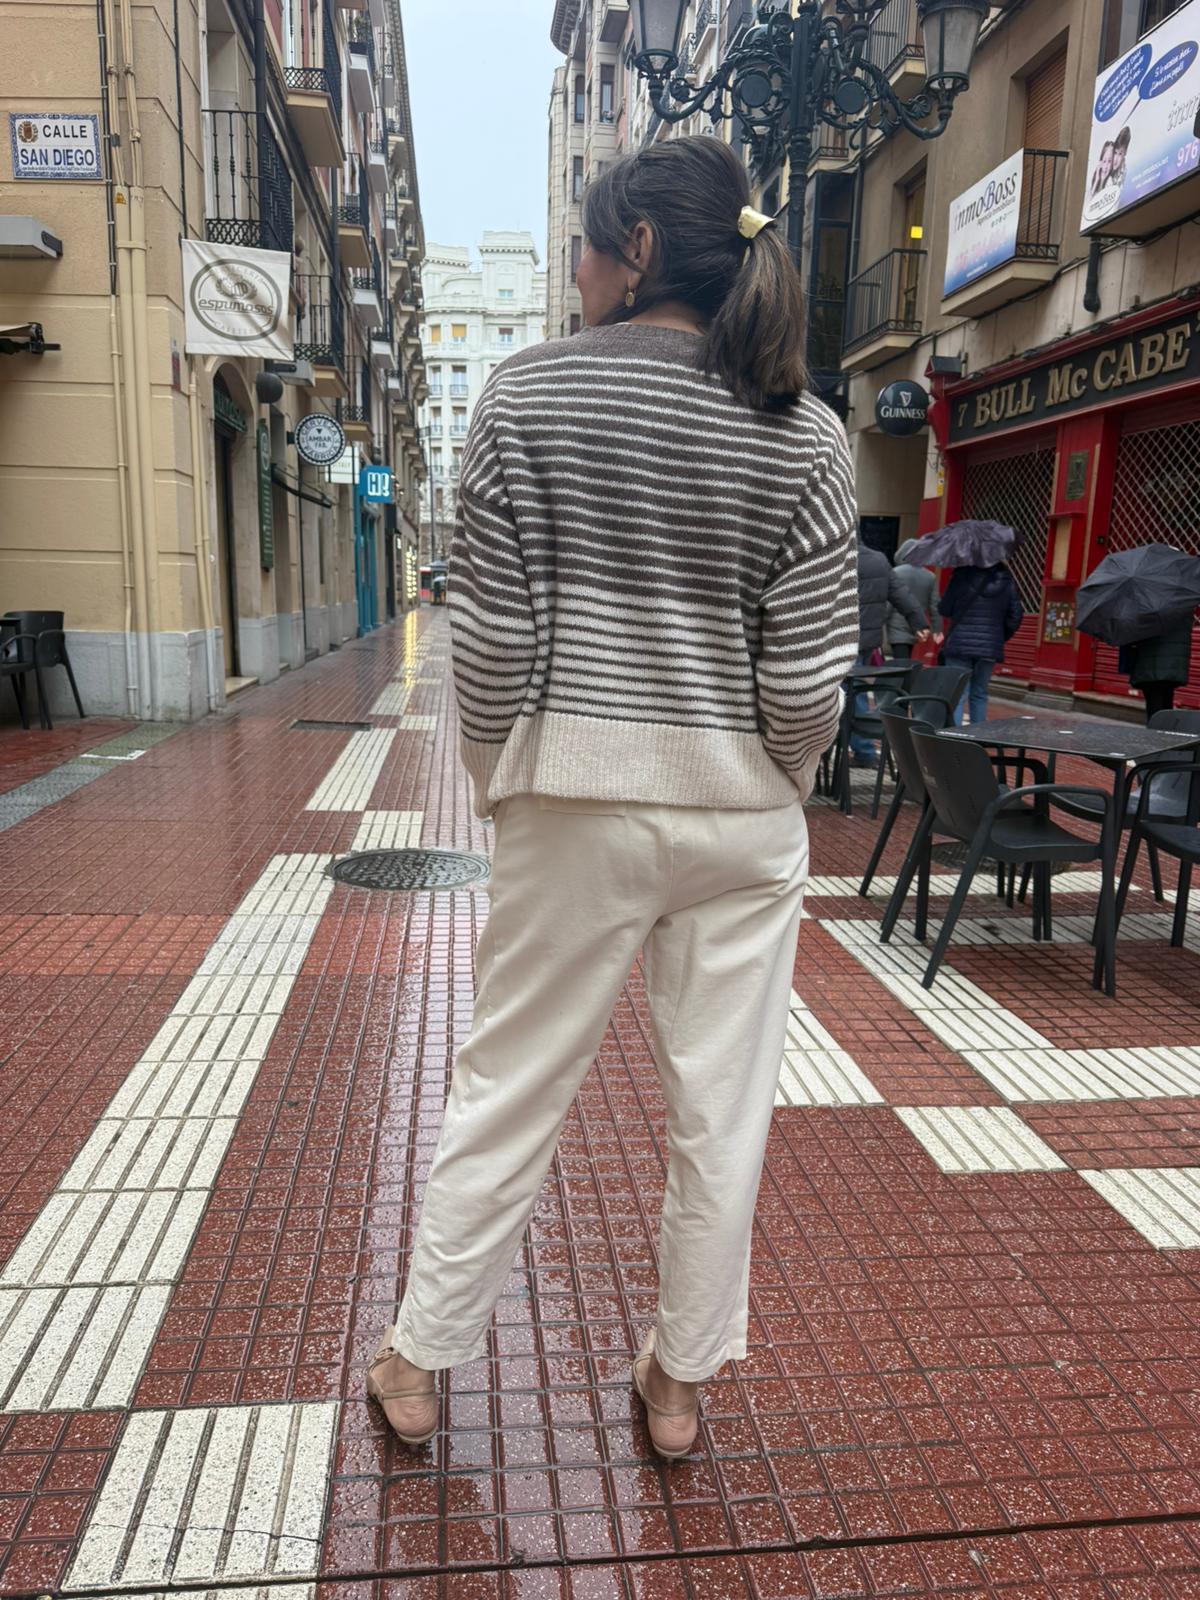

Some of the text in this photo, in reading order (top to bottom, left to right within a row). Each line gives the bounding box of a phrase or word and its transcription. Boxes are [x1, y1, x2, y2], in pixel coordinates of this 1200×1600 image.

[42, 124, 87, 138] CALLE
[20, 148, 95, 166] SAN DIEGO
[1176, 139, 1199, 168] 976
[198, 298, 273, 315] espumosos
[958, 403, 968, 427] 7
[973, 378, 1036, 428] BULL
[880, 405, 925, 419] GUINNESS
[302, 420, 338, 437] CERVEZA
